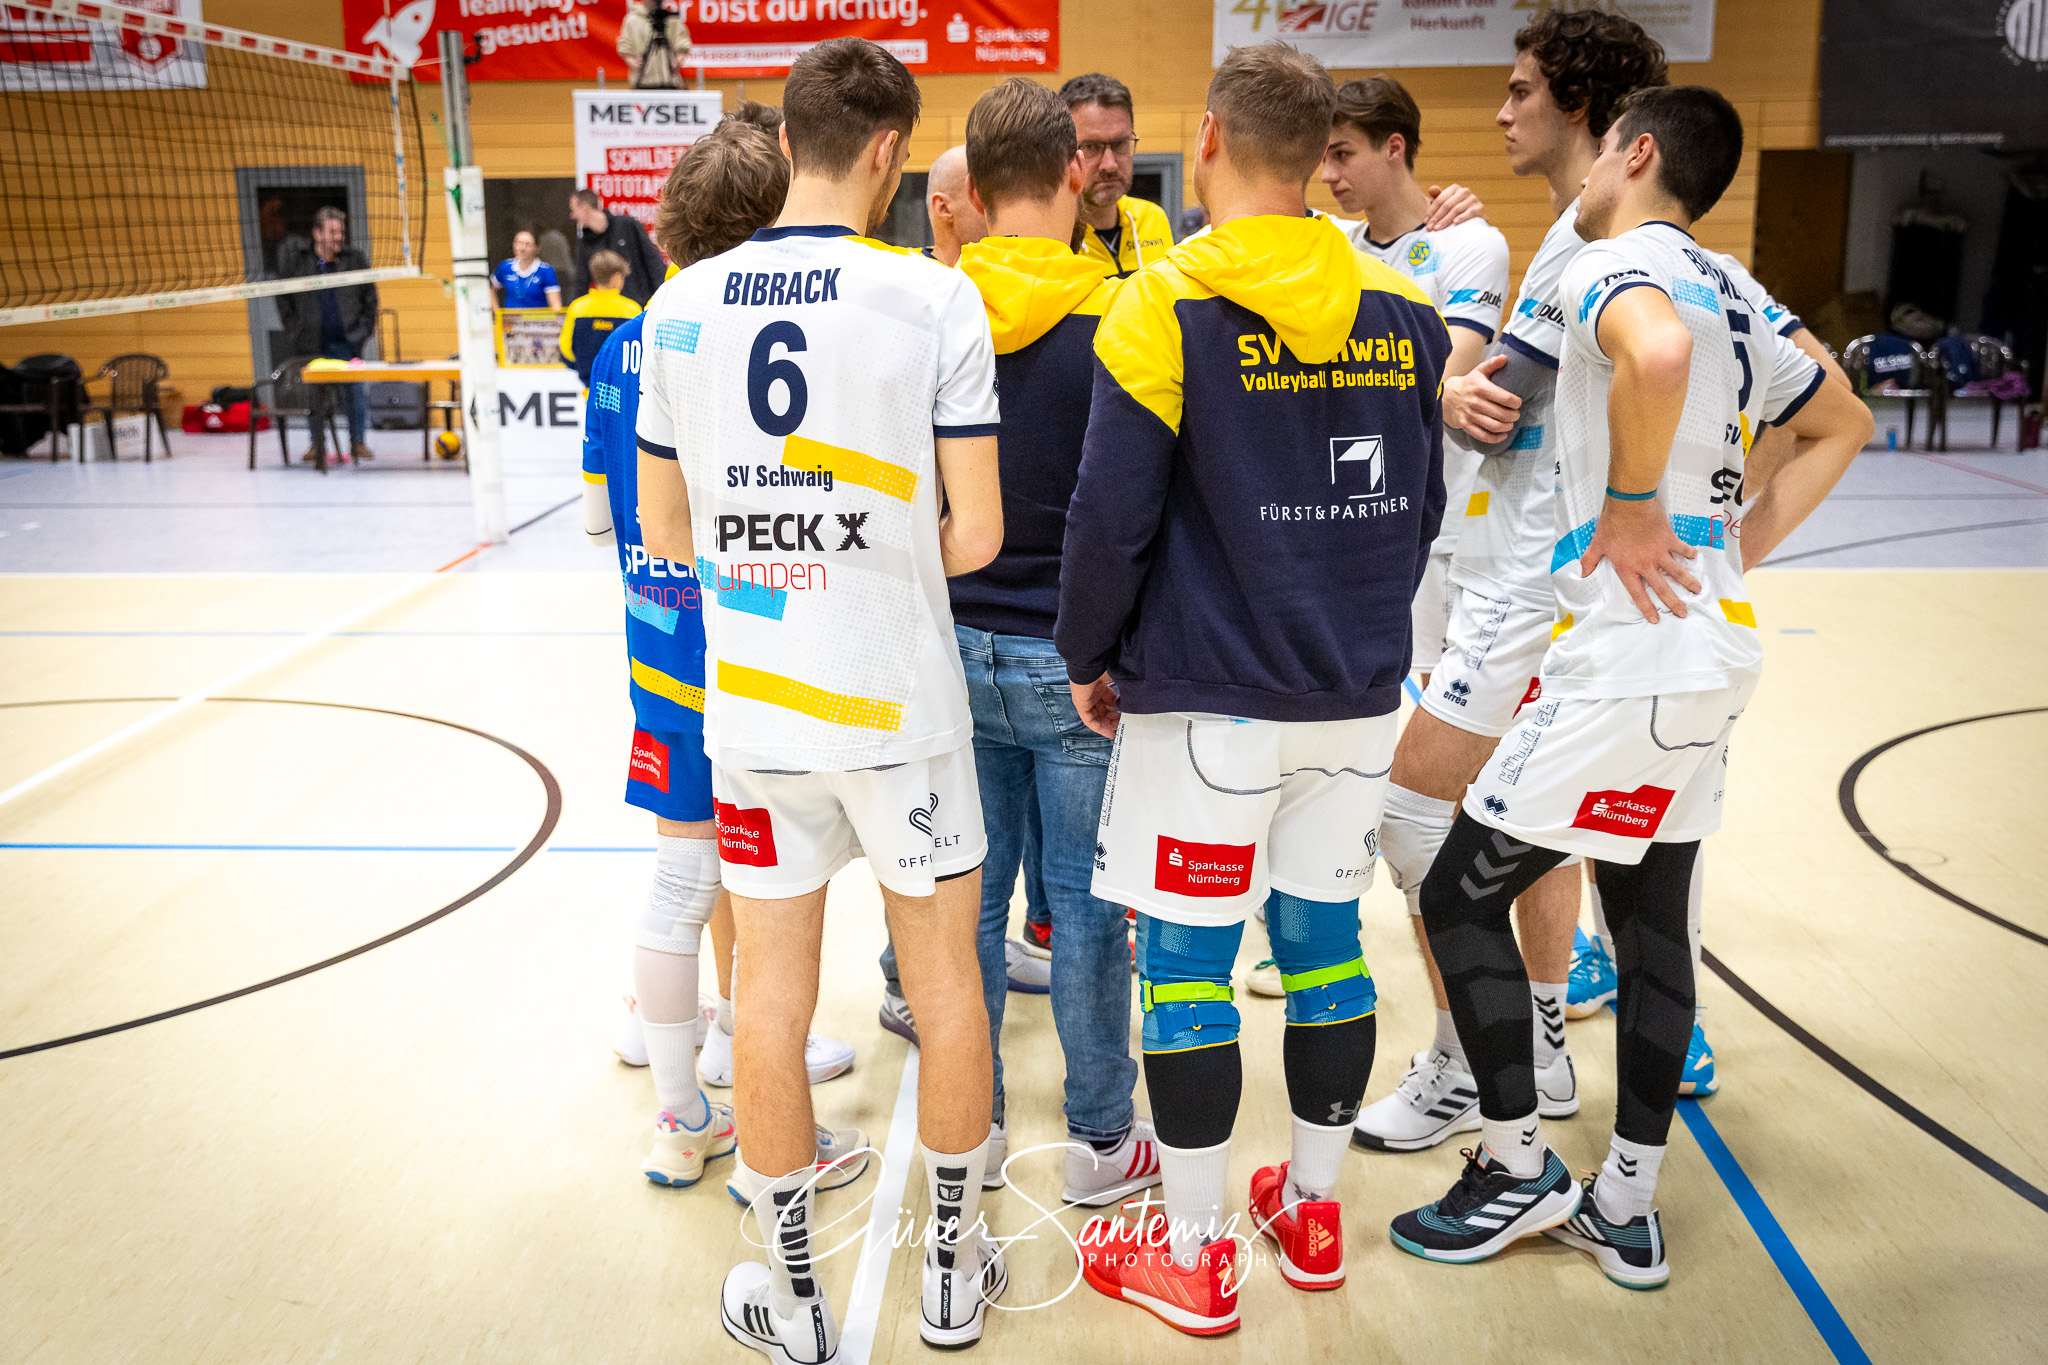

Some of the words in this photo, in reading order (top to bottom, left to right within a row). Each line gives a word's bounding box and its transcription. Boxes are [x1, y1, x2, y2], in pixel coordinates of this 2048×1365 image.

[700, 0, 759, 23] bist
[765, 0, 808, 22] du
[814, 0, 928, 26] richtig.
[1410, 14, 1485, 31] Herkunft
[480, 13, 588, 55] gesucht!
[974, 26, 1050, 45] Sparkasse
[974, 45, 1046, 65] Nürnberg
[589, 103, 707, 124] MEYSEL
[723, 268, 841, 306] BIBRACK
[1237, 333, 1282, 366] SV
[747, 320, 808, 437] 6
[1241, 370, 1326, 392] Volleyball
[1332, 368, 1416, 391] Bundesliga
[499, 392, 579, 427] ME
[727, 465, 749, 487] SV
[756, 465, 833, 492] Schwaig
[1260, 496, 1409, 521] FÜRST&PARTNER
[714, 512, 825, 552] PECK
[717, 562, 827, 598] umpen
[1443, 690, 1468, 707] errea
[1613, 799, 1657, 815] arkasse
[721, 837, 759, 855] Nürnberg
[1187, 860, 1244, 873] Sparkasse
[1187, 873, 1240, 885] Nürnberg
[1308, 1218, 1318, 1257] adidas
